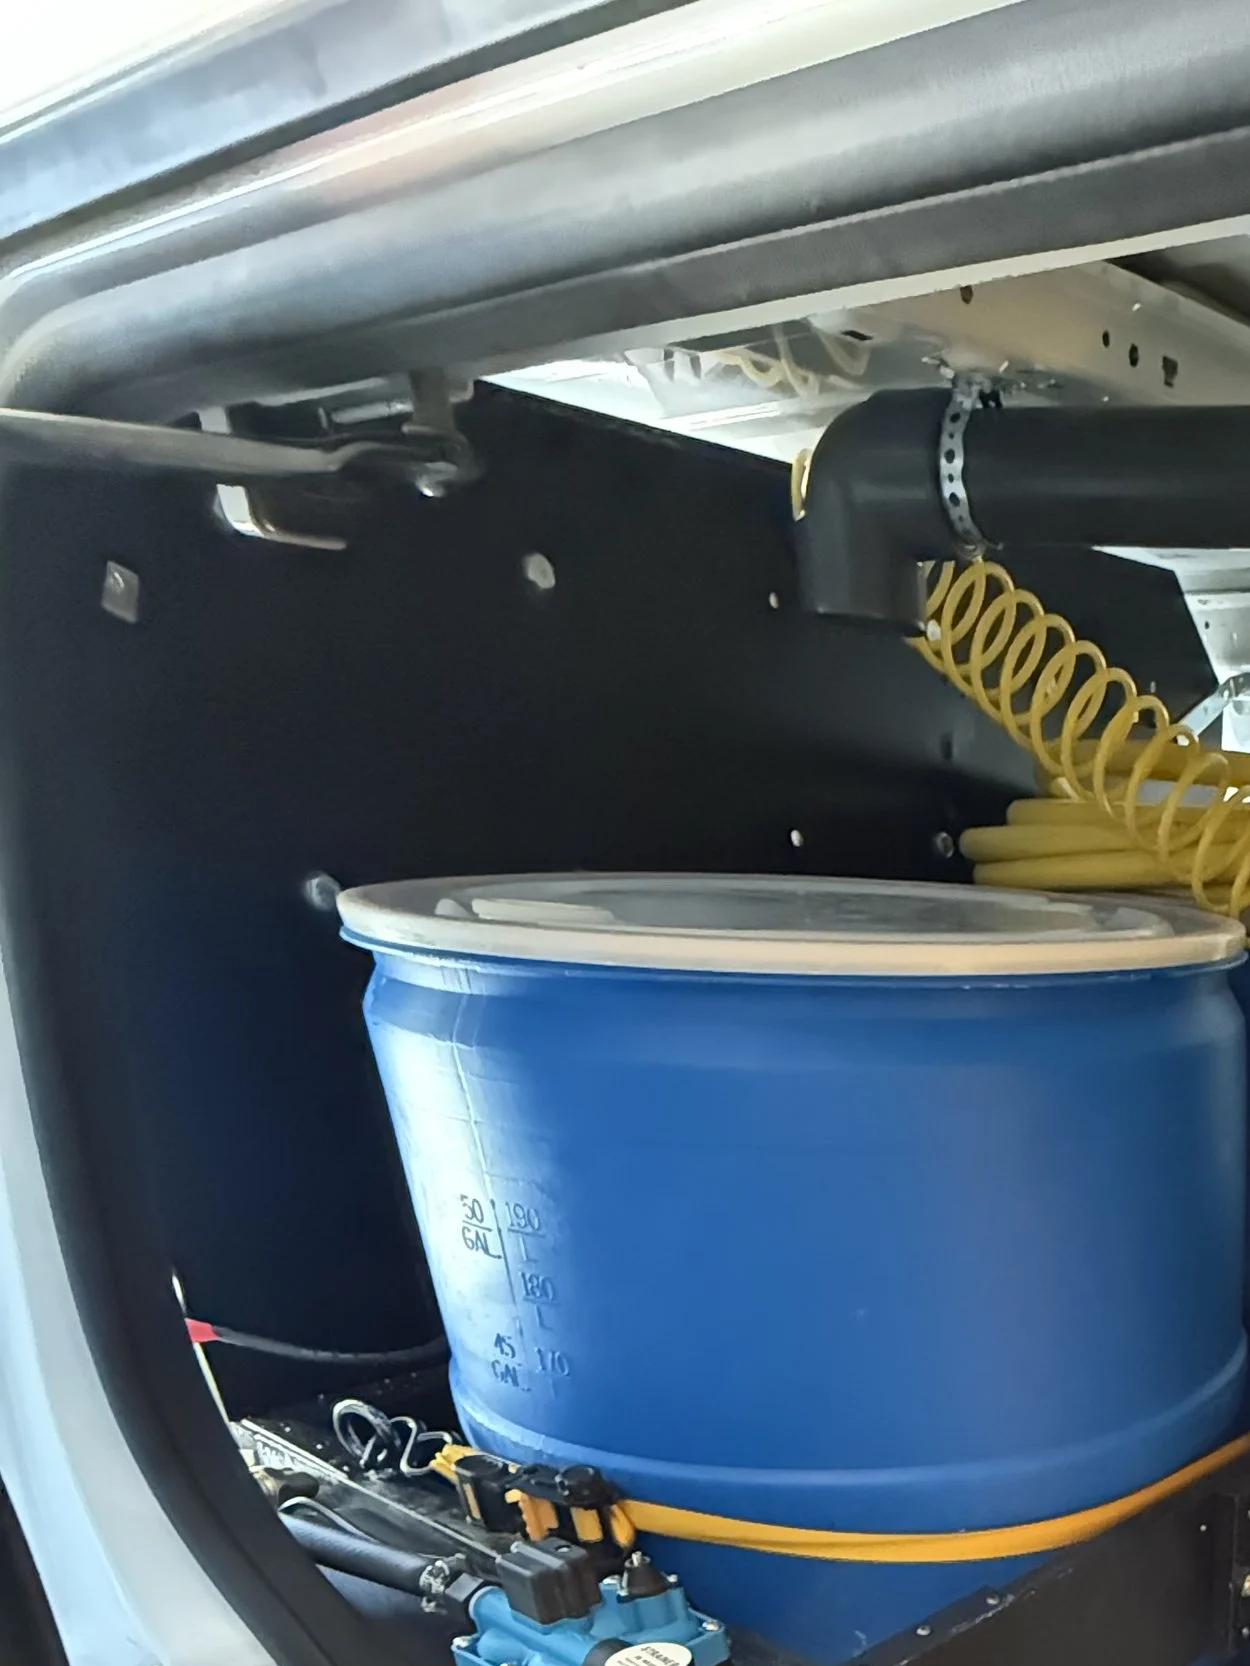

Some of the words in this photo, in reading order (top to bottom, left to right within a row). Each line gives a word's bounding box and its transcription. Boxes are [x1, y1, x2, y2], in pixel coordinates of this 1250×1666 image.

[505, 1201, 541, 1231] 190
[462, 1226, 502, 1260] GAL
[418, 1489, 451, 1533] WLL
